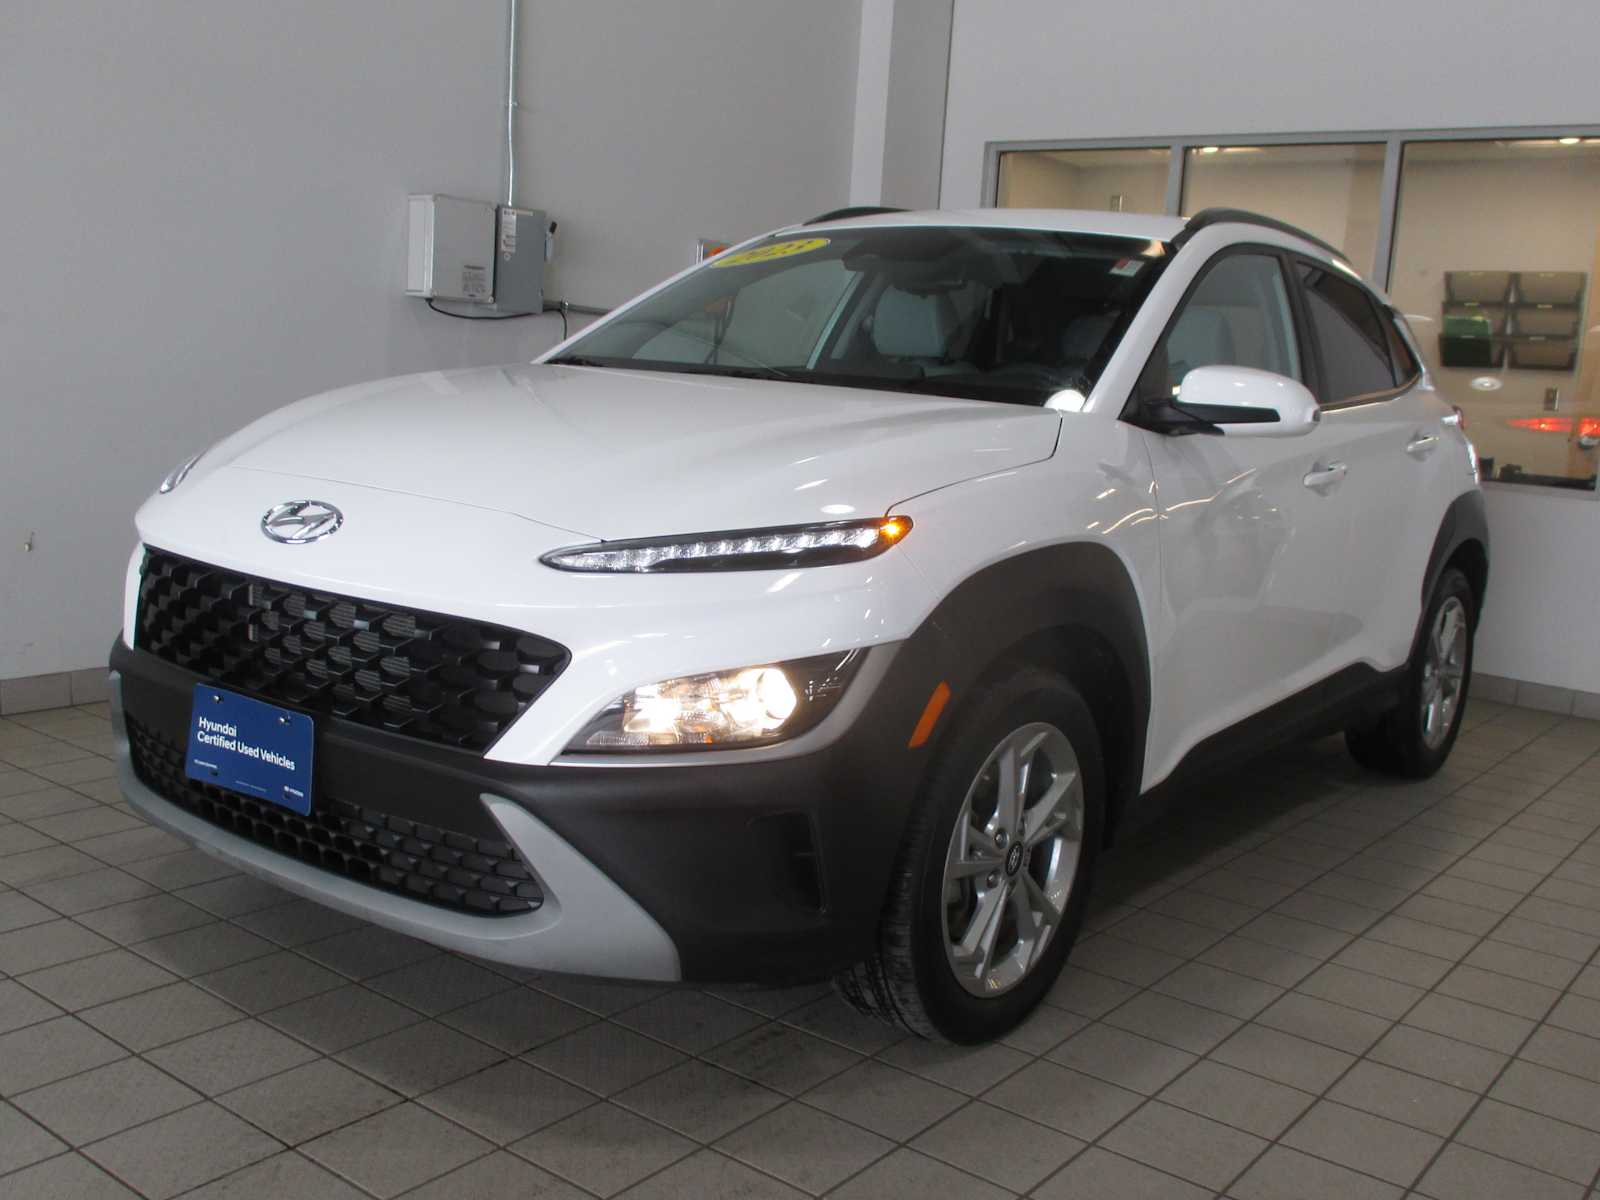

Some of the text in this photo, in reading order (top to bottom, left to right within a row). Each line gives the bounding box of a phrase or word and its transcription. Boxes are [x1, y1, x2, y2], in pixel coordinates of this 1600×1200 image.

[198, 716, 237, 736] Hyundai
[197, 730, 296, 771] Certified Used Vehicles
